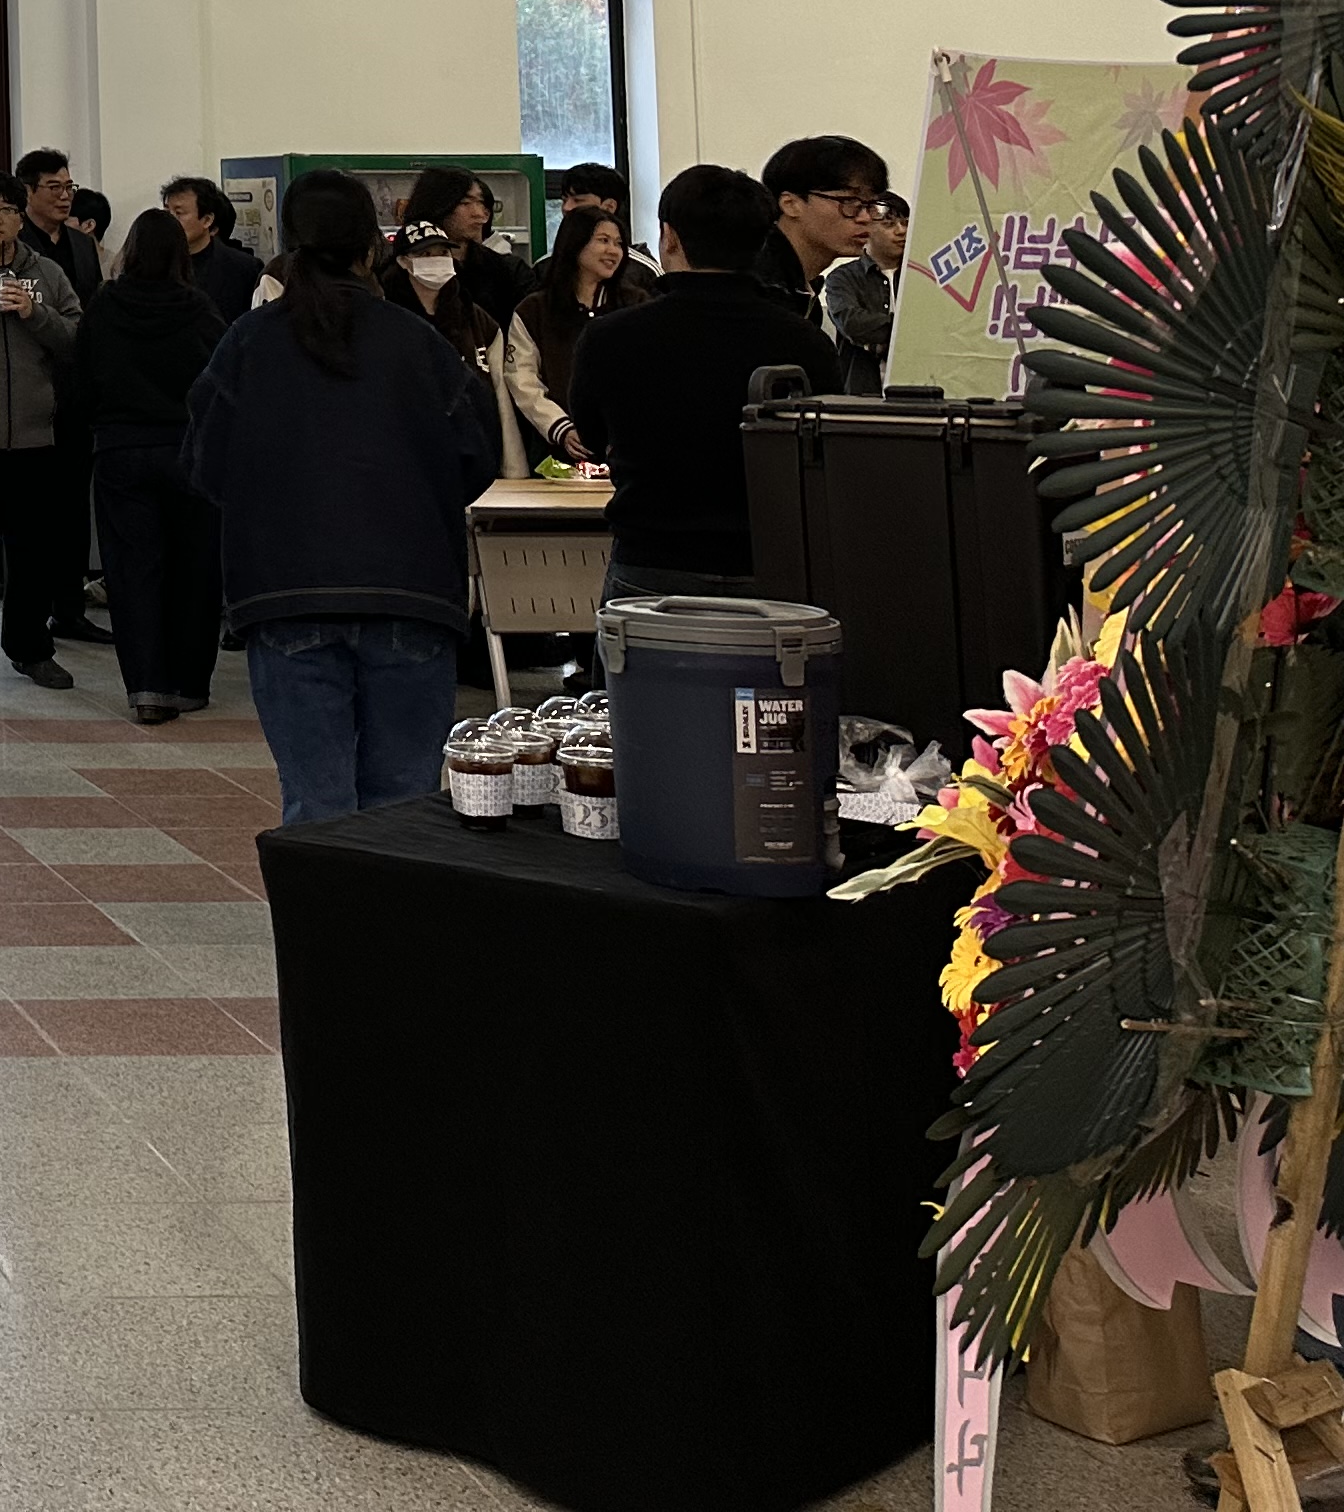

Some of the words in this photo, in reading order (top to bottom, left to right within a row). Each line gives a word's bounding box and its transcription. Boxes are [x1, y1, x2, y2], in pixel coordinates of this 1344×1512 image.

[758, 699, 804, 712] WATER
[759, 712, 787, 724] JUG
[576, 803, 609, 829] 23
